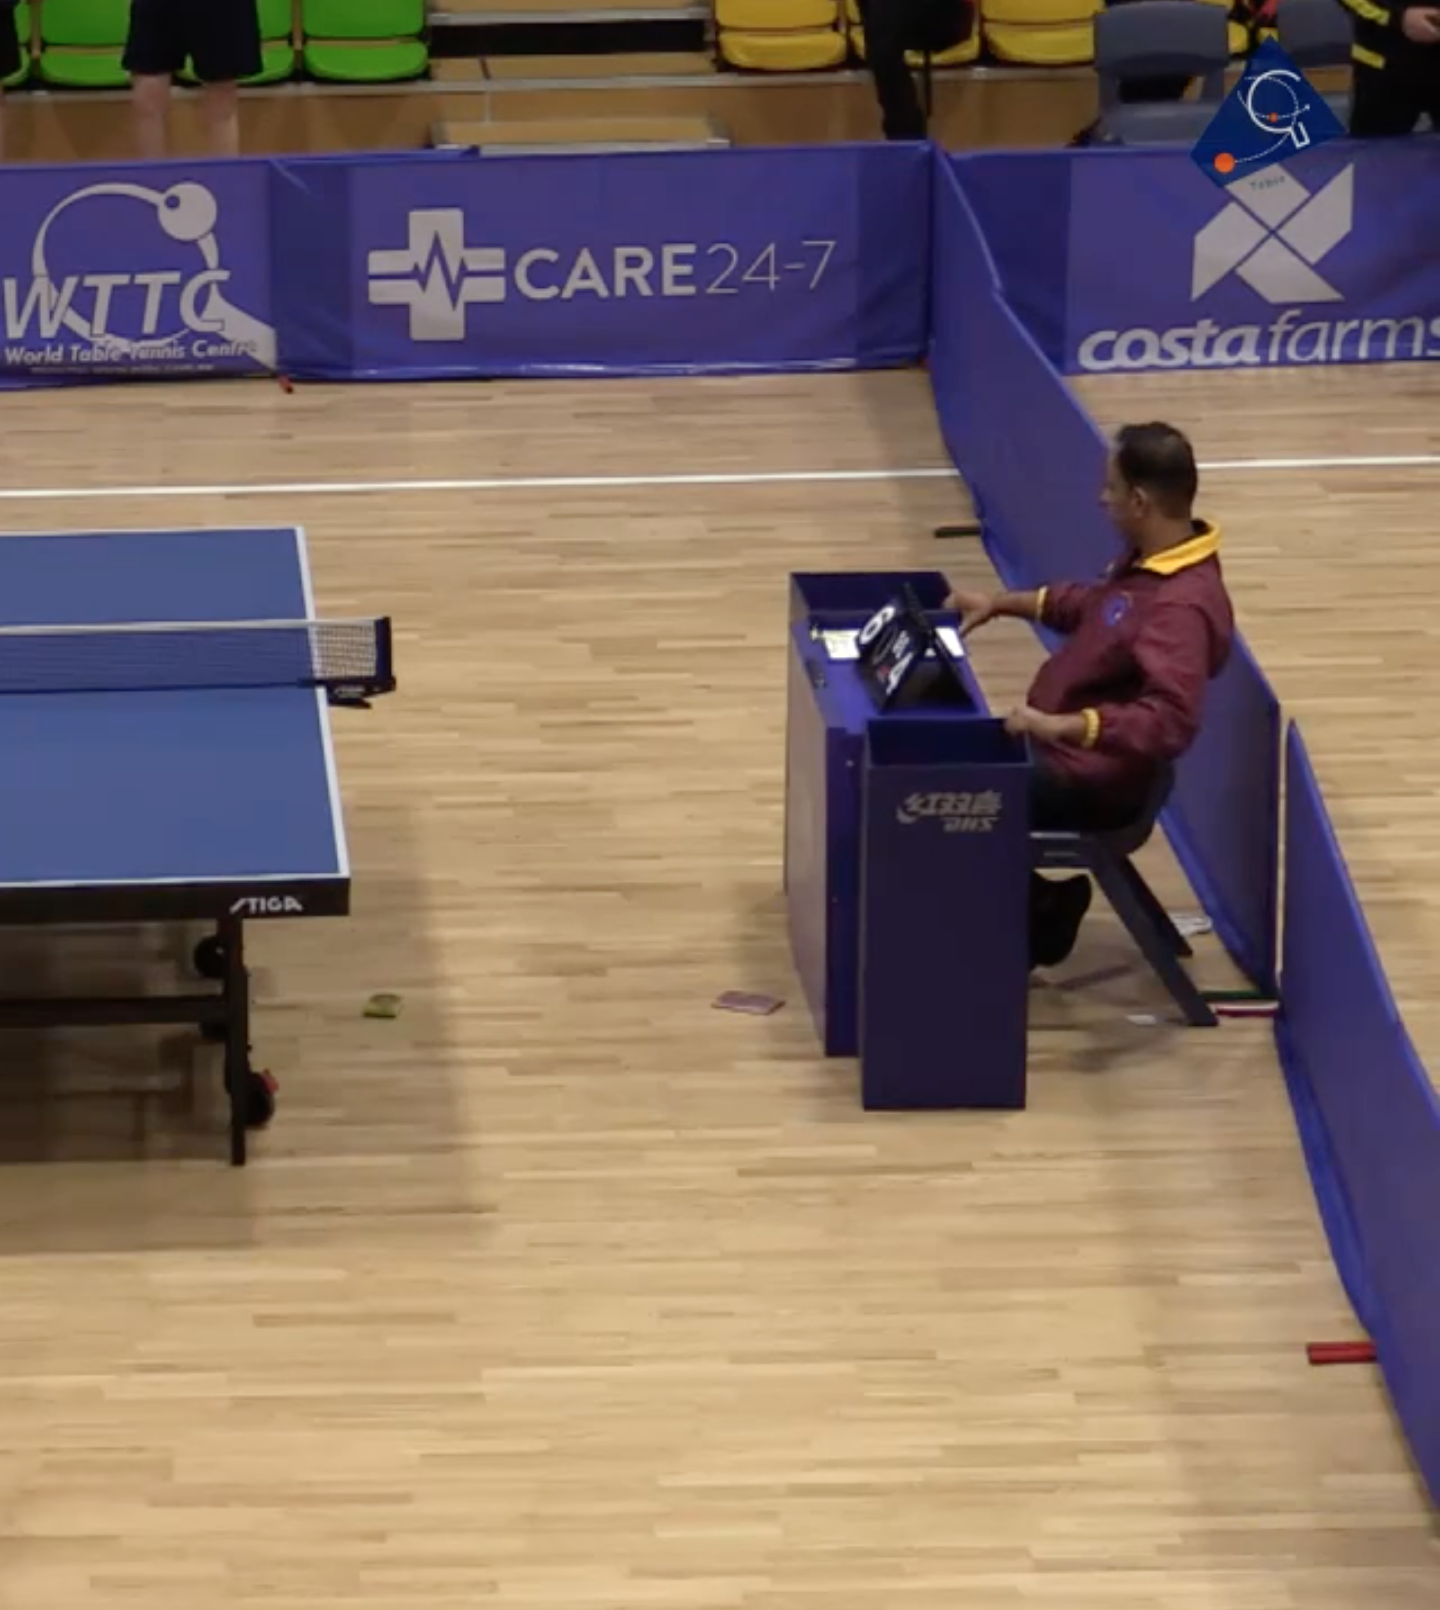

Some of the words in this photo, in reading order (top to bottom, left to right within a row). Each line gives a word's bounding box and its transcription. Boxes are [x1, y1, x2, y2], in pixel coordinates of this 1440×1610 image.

[3, 270, 231, 339] WTTC
[4, 343, 64, 365] World
[229, 895, 304, 915] STIGA
